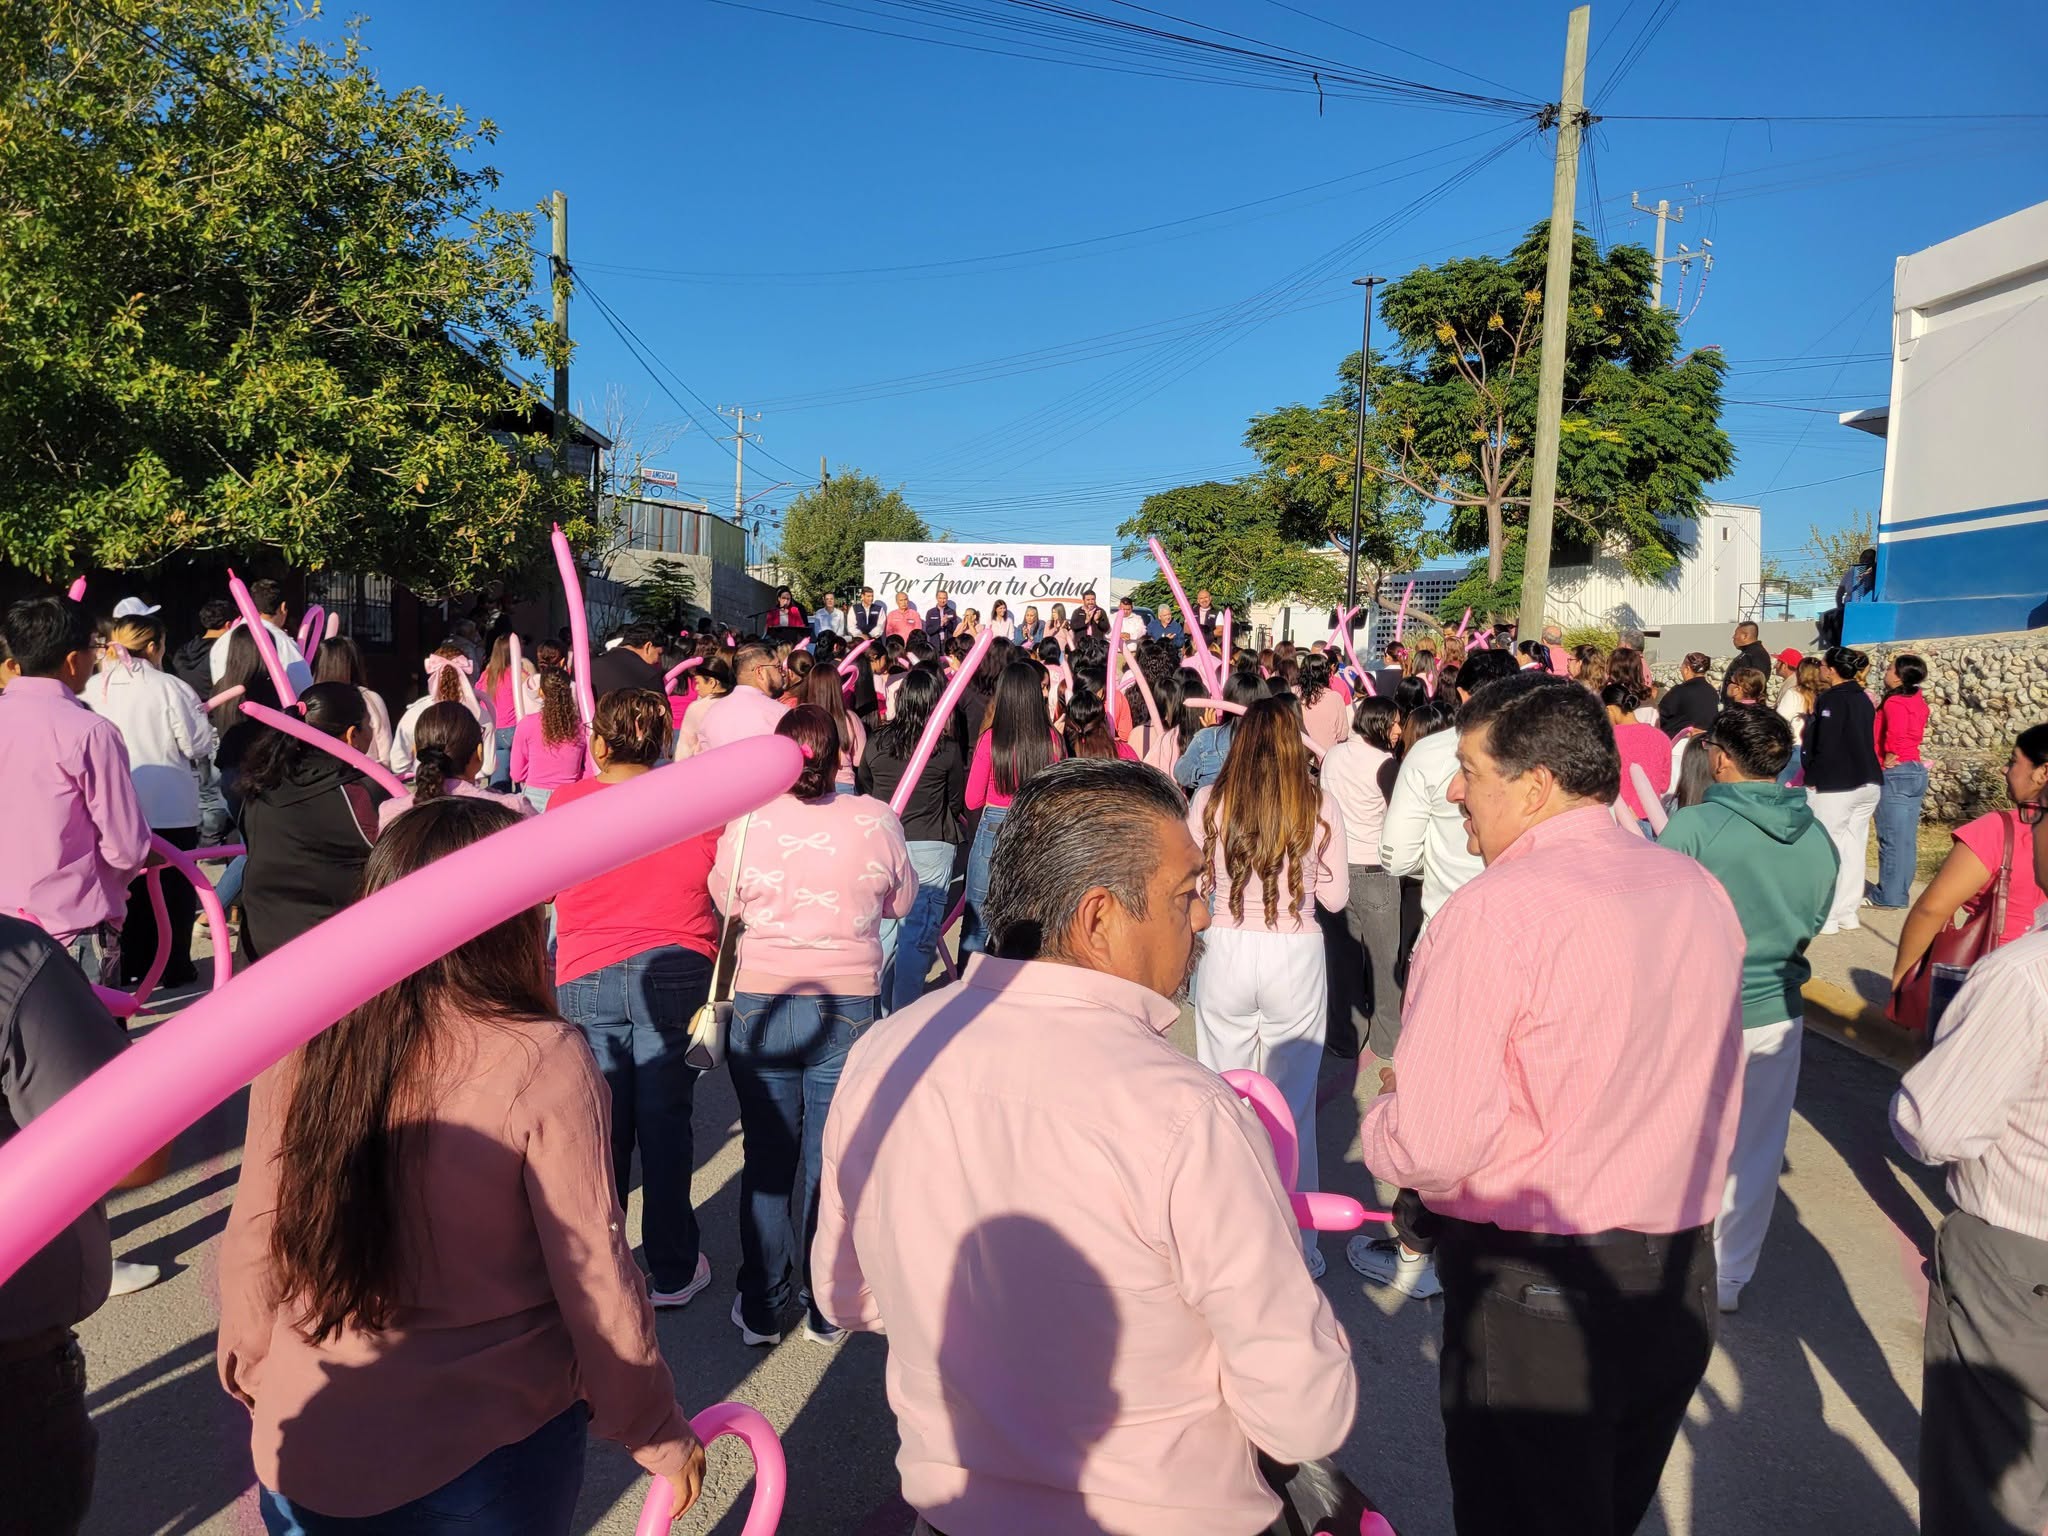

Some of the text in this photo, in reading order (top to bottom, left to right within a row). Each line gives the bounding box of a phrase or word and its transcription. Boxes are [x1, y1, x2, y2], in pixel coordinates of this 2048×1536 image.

[652, 470, 675, 480] AMERICAN
[916, 555, 955, 564] COAHUILA
[971, 554, 1017, 568] ACUÑA
[879, 571, 1098, 597] Por Amor a tu Salud
